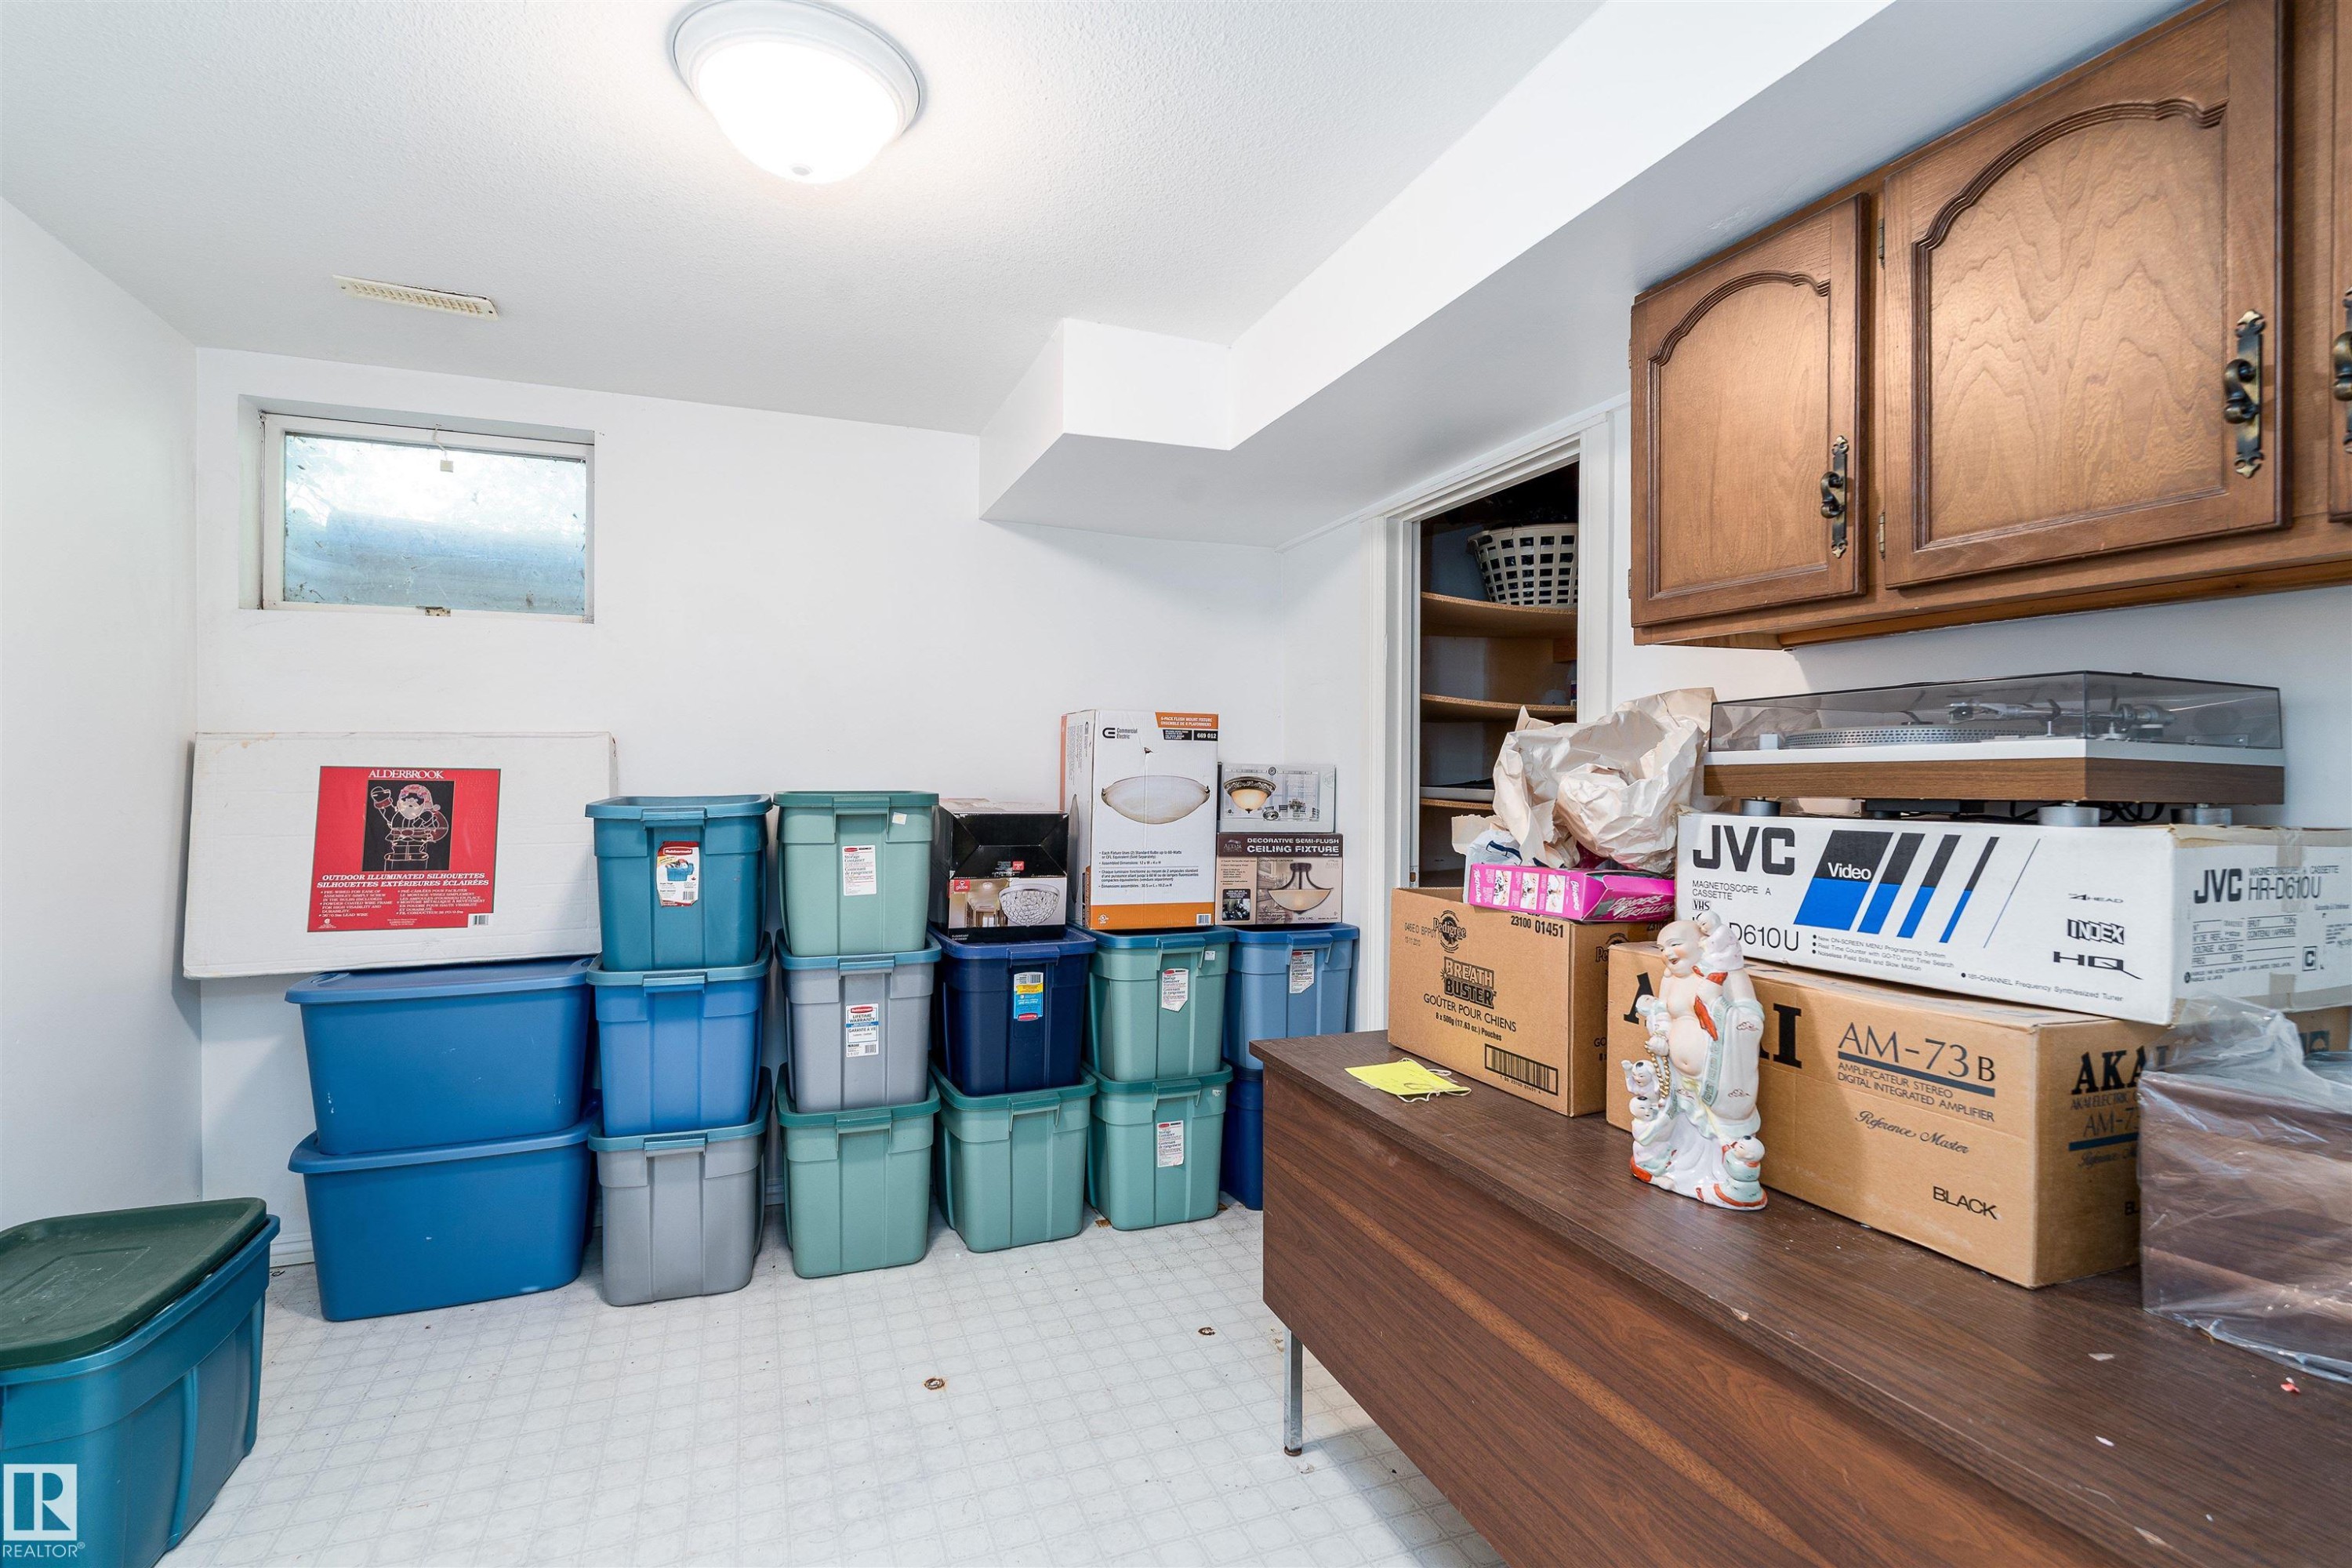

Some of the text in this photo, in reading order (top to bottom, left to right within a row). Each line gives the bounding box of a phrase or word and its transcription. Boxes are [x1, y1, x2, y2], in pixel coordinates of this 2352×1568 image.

[368, 770, 444, 779] ALDERBROOK
[1693, 825, 1795, 876] JVC
[1828, 862, 1872, 880] Video
[2249, 865, 2339, 876] MAGNETOSCOPE CASSETTE
[1692, 880, 1759, 895] MAGNETOSCOPE
[1692, 888, 1733, 900] CASSETTE
[2194, 868, 2243, 904] JVC
[2248, 876, 2321, 901] HR-D610U
[1693, 900, 1710, 911] VHS
[1433, 917, 1467, 938] Pedigree
[1511, 915, 1564, 938] 23100 01451
[2067, 919, 2125, 945] INDEX
[1818, 950, 1842, 960] Noiseless
[1831, 937, 1864, 947] ON-SCREEN
[1885, 946, 1922, 956] Programming
[1924, 951, 1947, 960] System
[1846, 947, 1867, 956] Counter
[1933, 960, 1955, 968] Search
[2304, 950, 2315, 967] C
[1446, 958, 1494, 988] BREATH
[2053, 951, 2143, 980] HQ
[1445, 978, 1494, 1007] BUSTER
[2015, 980, 2052, 993] Frequency
[2054, 986, 2099, 999] Synthesized
[2102, 993, 2124, 1002] Tuner
[1424, 993, 1517, 1033] GOÛTER POUR CHIENS
[1443, 1014, 1455, 1026] 500g
[1455, 1018, 1471, 1031] (17.63
[1481, 1027, 1502, 1041] Pouches
[1838, 1022, 1996, 1082] AM-73 B
[1838, 1062, 1953, 1098] AMPLIFICATEUR STEREO
[1838, 1072, 1995, 1123] DIGITAL INTEGRATED AMPLIFIER
[1855, 1110, 1969, 1154] Reference Master
[1933, 1186, 1998, 1220] BLACK
